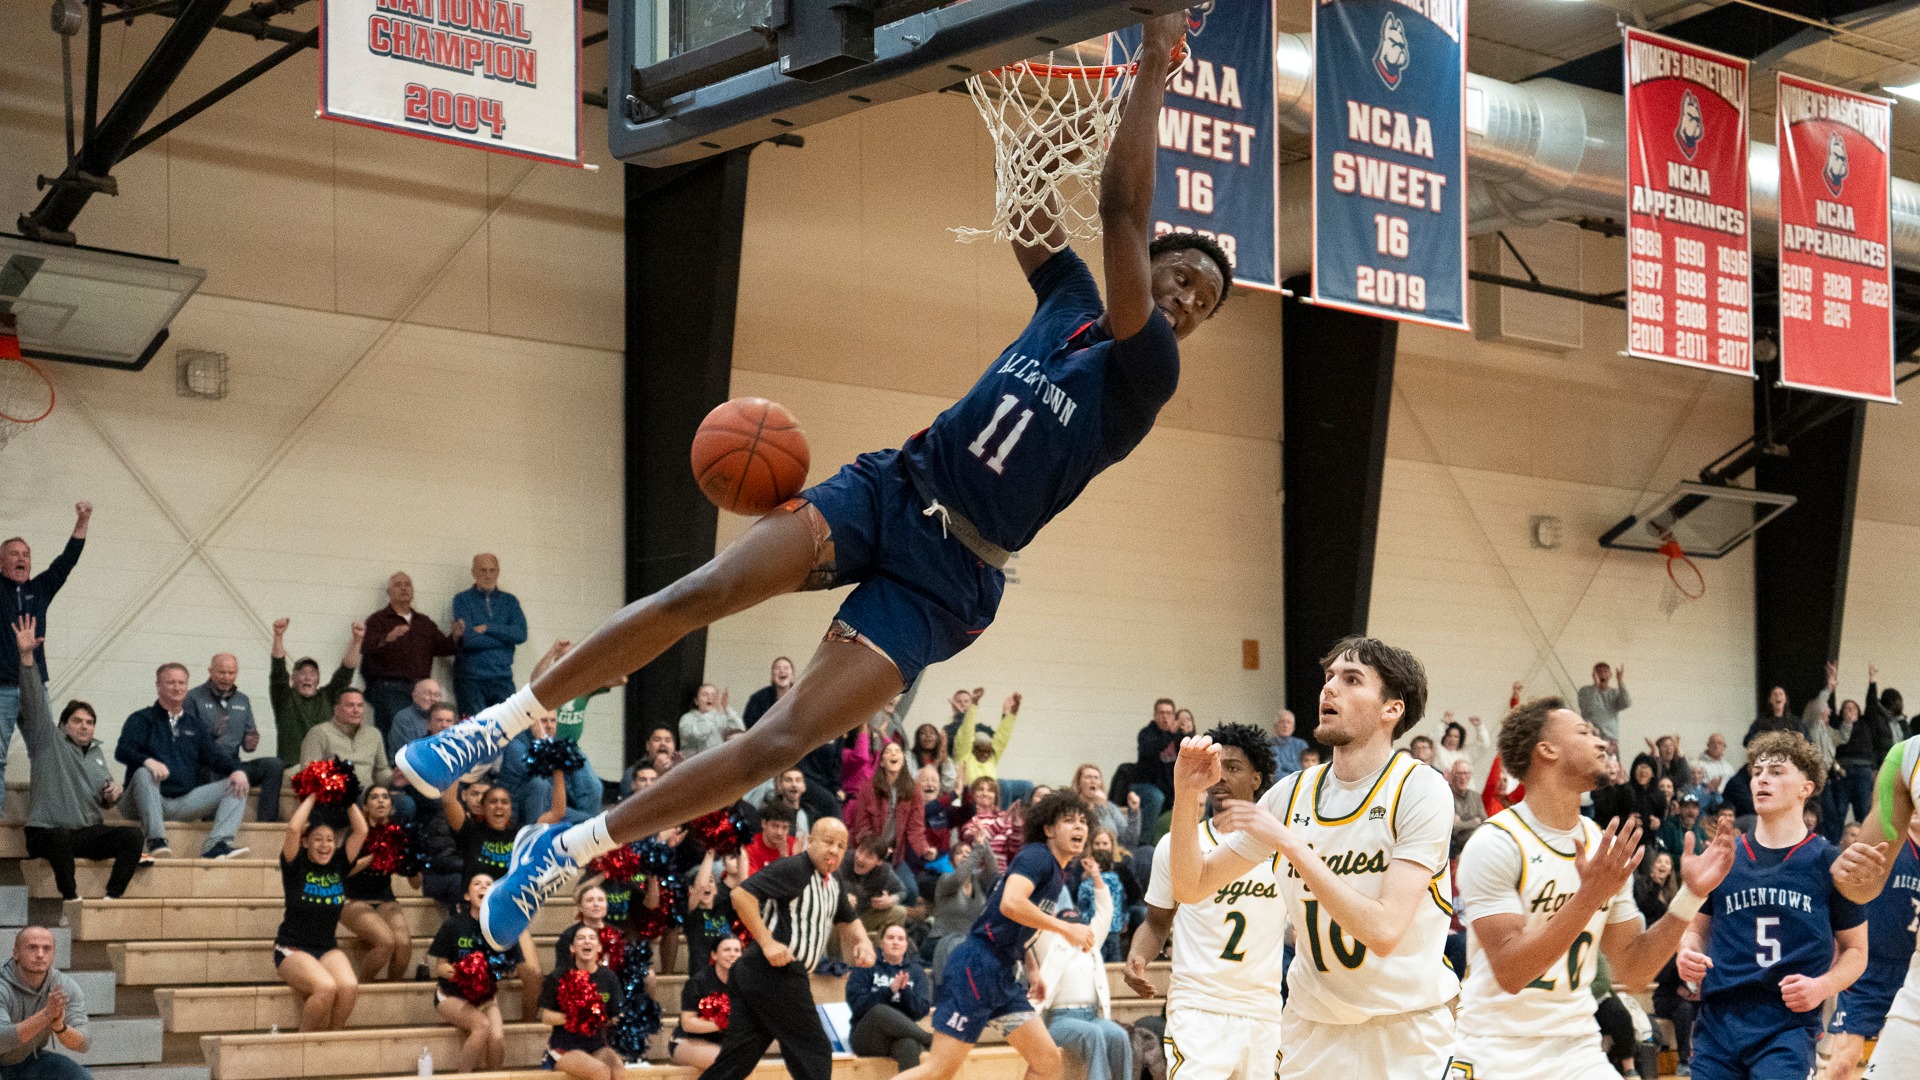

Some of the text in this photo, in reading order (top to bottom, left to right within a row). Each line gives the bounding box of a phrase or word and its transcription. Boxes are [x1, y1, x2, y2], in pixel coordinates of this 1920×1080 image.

[369, 14, 537, 90] CHAMPION
[1164, 58, 1242, 110] CAA
[1681, 52, 1742, 112] BASKETBALL
[404, 82, 506, 140] 2004
[1346, 100, 1434, 158] NCAA
[1158, 106, 1256, 166] WEET
[1175, 165, 1214, 214] 16
[1333, 150, 1446, 213] SWEET
[1667, 161, 1711, 199] NCAA
[1632, 185, 1745, 236] APPEARANCES
[1816, 199, 1856, 233] NCAA
[1374, 213, 1409, 258] 16
[1631, 227, 1748, 276] 1989 1990 1996
[1784, 223, 1887, 270] APPEARANCES
[1356, 264, 1426, 311] 2019
[1631, 259, 1748, 307] 1997 1998 2000
[1782, 263, 1813, 293] 2019
[1632, 290, 1664, 322] 2003
[1782, 291, 1813, 321] 2023
[1632, 321, 1749, 369] 2010 2011 2017
[967, 394, 1034, 475] 11
[1214, 880, 1277, 905] ggies
[1725, 887, 1812, 915] ALLENTOWN
[1219, 911, 1247, 962] 2
[1756, 917, 1782, 968] 5
[947, 1012, 969, 1031] AC
